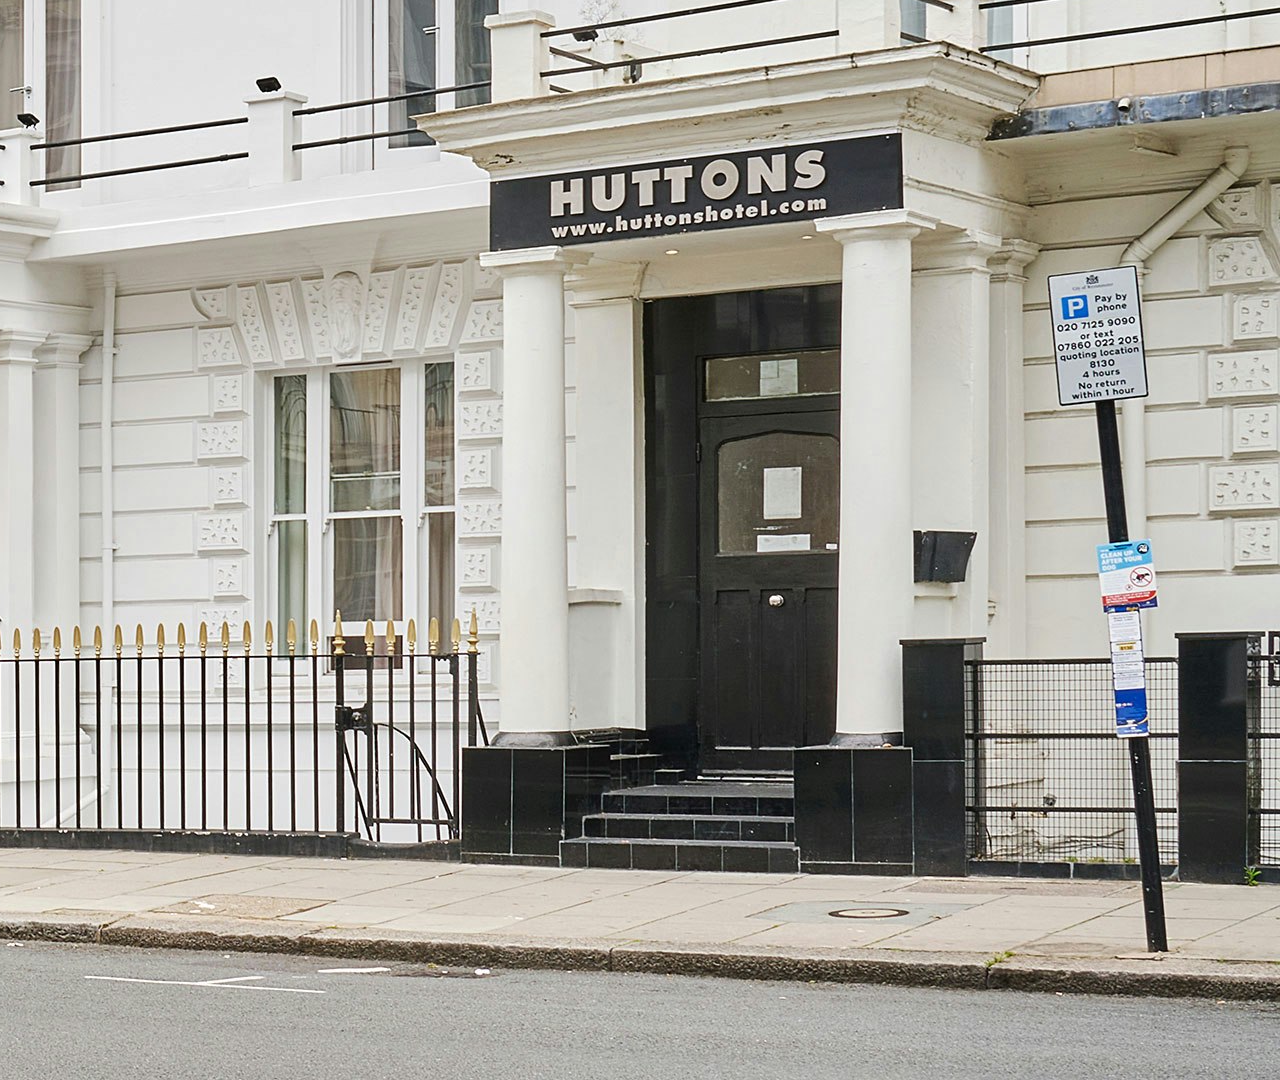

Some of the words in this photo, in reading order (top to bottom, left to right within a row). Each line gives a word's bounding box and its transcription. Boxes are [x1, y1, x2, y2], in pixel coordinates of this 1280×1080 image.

[550, 149, 826, 218] HUTTONS
[550, 195, 827, 239] www.huttonshotel.com
[1115, 293, 1127, 301] by
[1068, 298, 1084, 317] P
[1097, 304, 1127, 313] phone
[1057, 323, 1078, 332] 020
[1081, 320, 1104, 329] 7125
[1108, 316, 1135, 326] 9090
[1094, 330, 1114, 338] text
[1058, 341, 1091, 351] 07860
[1095, 338, 1115, 347] 022
[1118, 336, 1139, 345] 205
[1060, 351, 1097, 361] quoting
[1100, 346, 1140, 356] location
[1090, 359, 1115, 368] 8130
[1093, 369, 1120, 377] hours
[1078, 382, 1092, 390] No
[1095, 379, 1127, 388] return
[1072, 390, 1102, 400] within
[1113, 386, 1135, 395] hour
